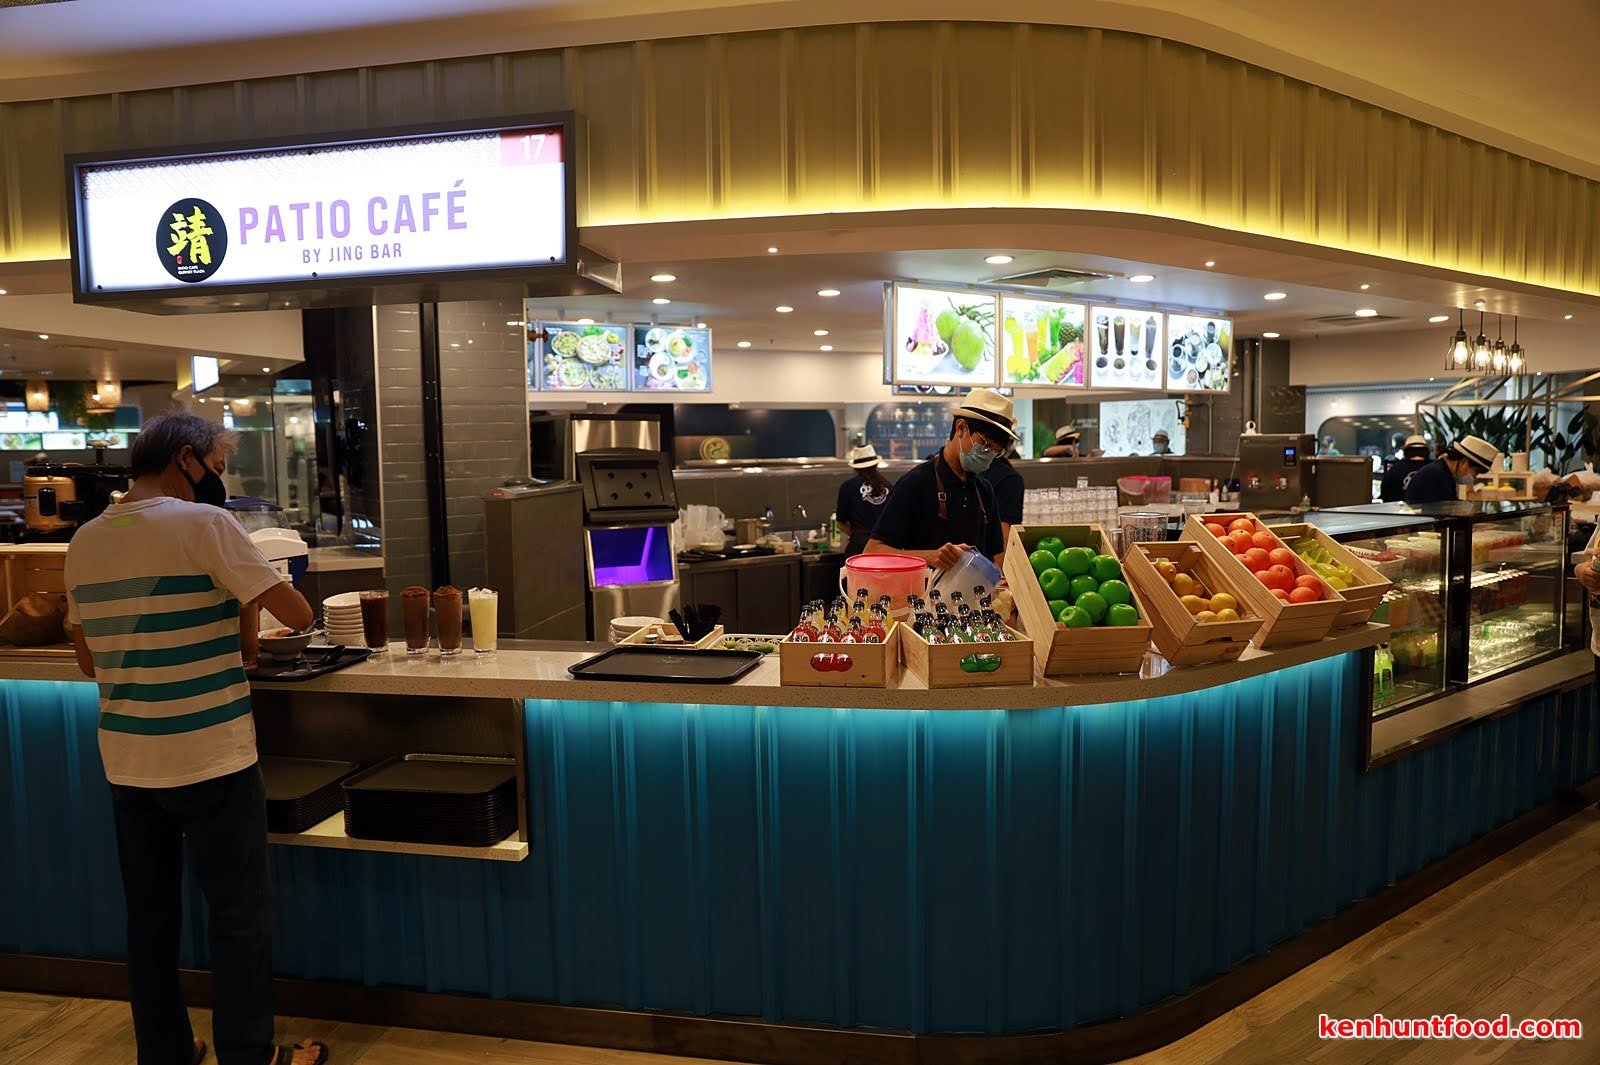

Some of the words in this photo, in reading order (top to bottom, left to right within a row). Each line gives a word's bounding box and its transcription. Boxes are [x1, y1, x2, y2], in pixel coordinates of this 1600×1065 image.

[520, 134, 546, 161] 17
[239, 199, 350, 245] PATIO
[367, 179, 467, 235] CAFÉ
[302, 248, 321, 263] BY
[329, 245, 363, 262] JING
[371, 242, 402, 259] BAR
